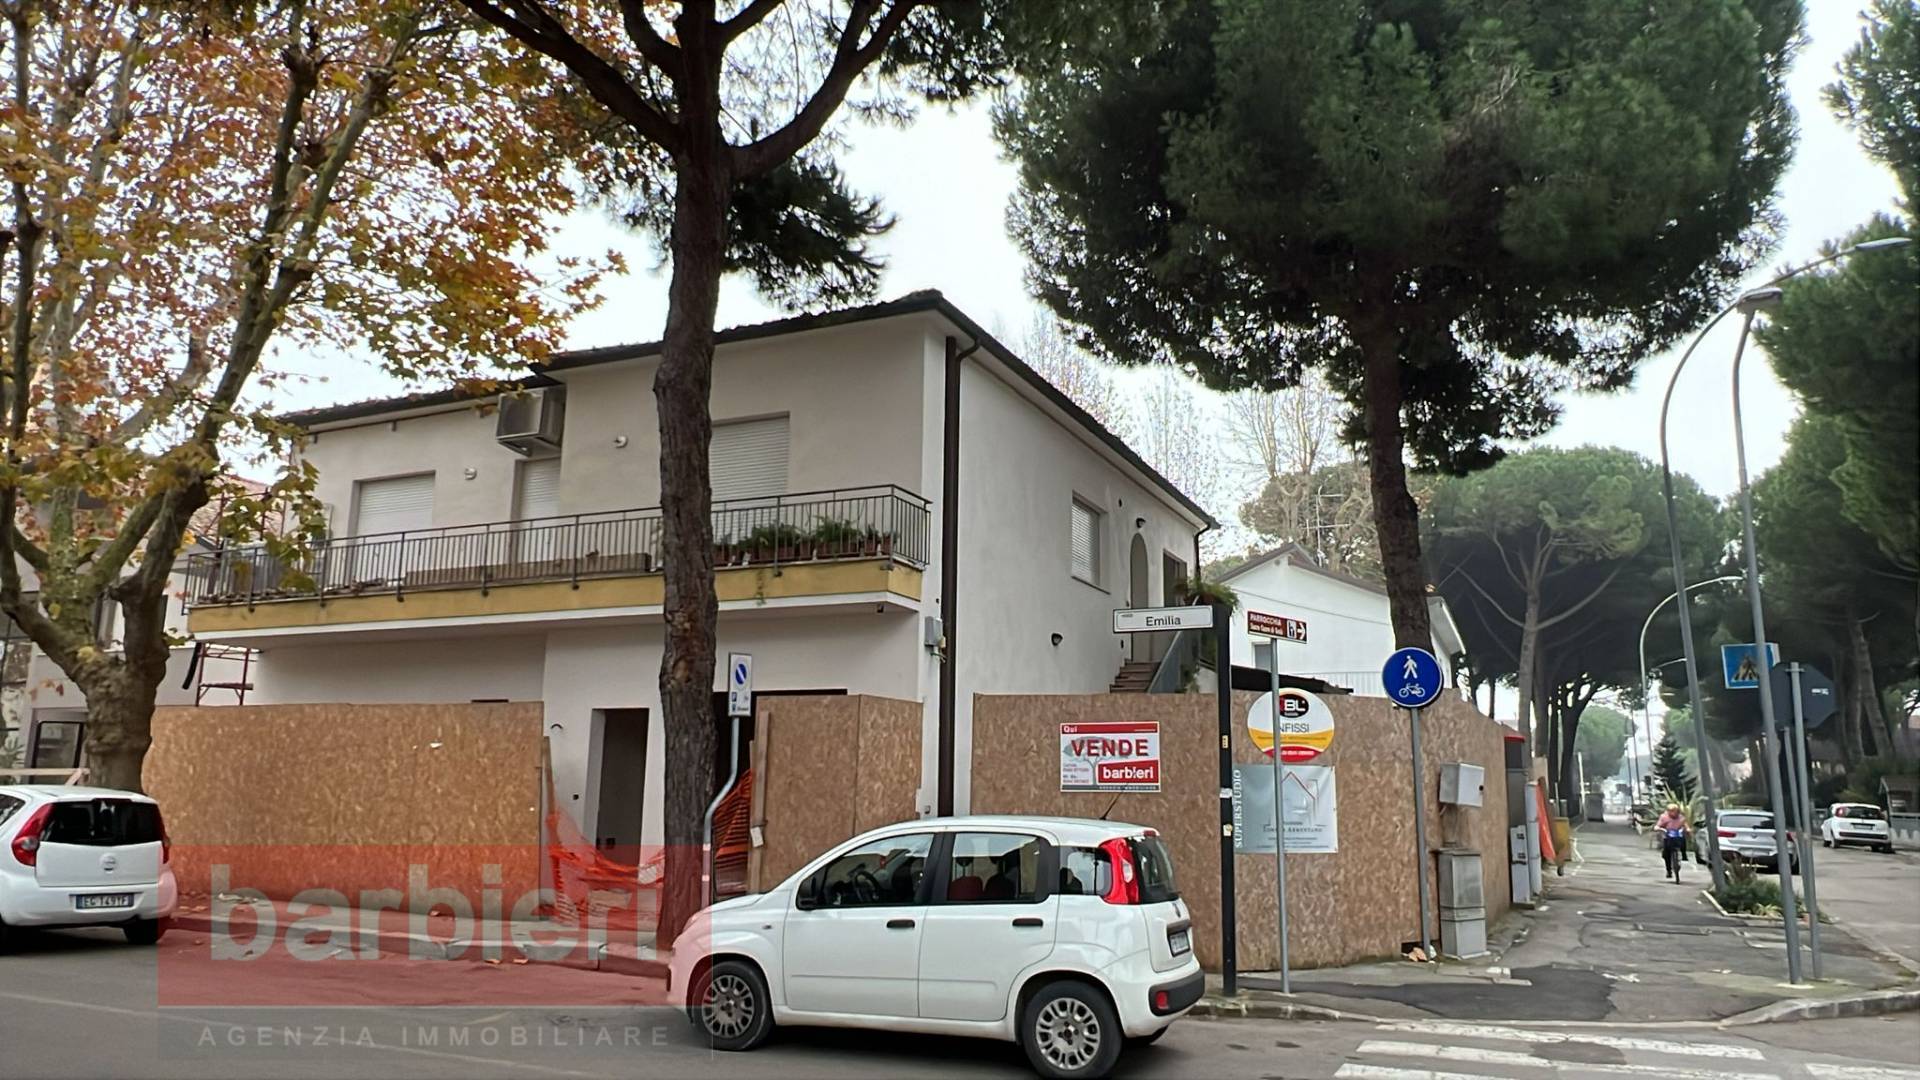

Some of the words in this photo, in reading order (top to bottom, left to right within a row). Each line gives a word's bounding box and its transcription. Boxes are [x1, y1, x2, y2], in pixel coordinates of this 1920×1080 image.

[1145, 616, 1181, 627] Emilia
[1071, 738, 1149, 757] VENDE
[1102, 766, 1154, 779] barbieri
[1233, 769, 1243, 848] SUPERSTUDIO
